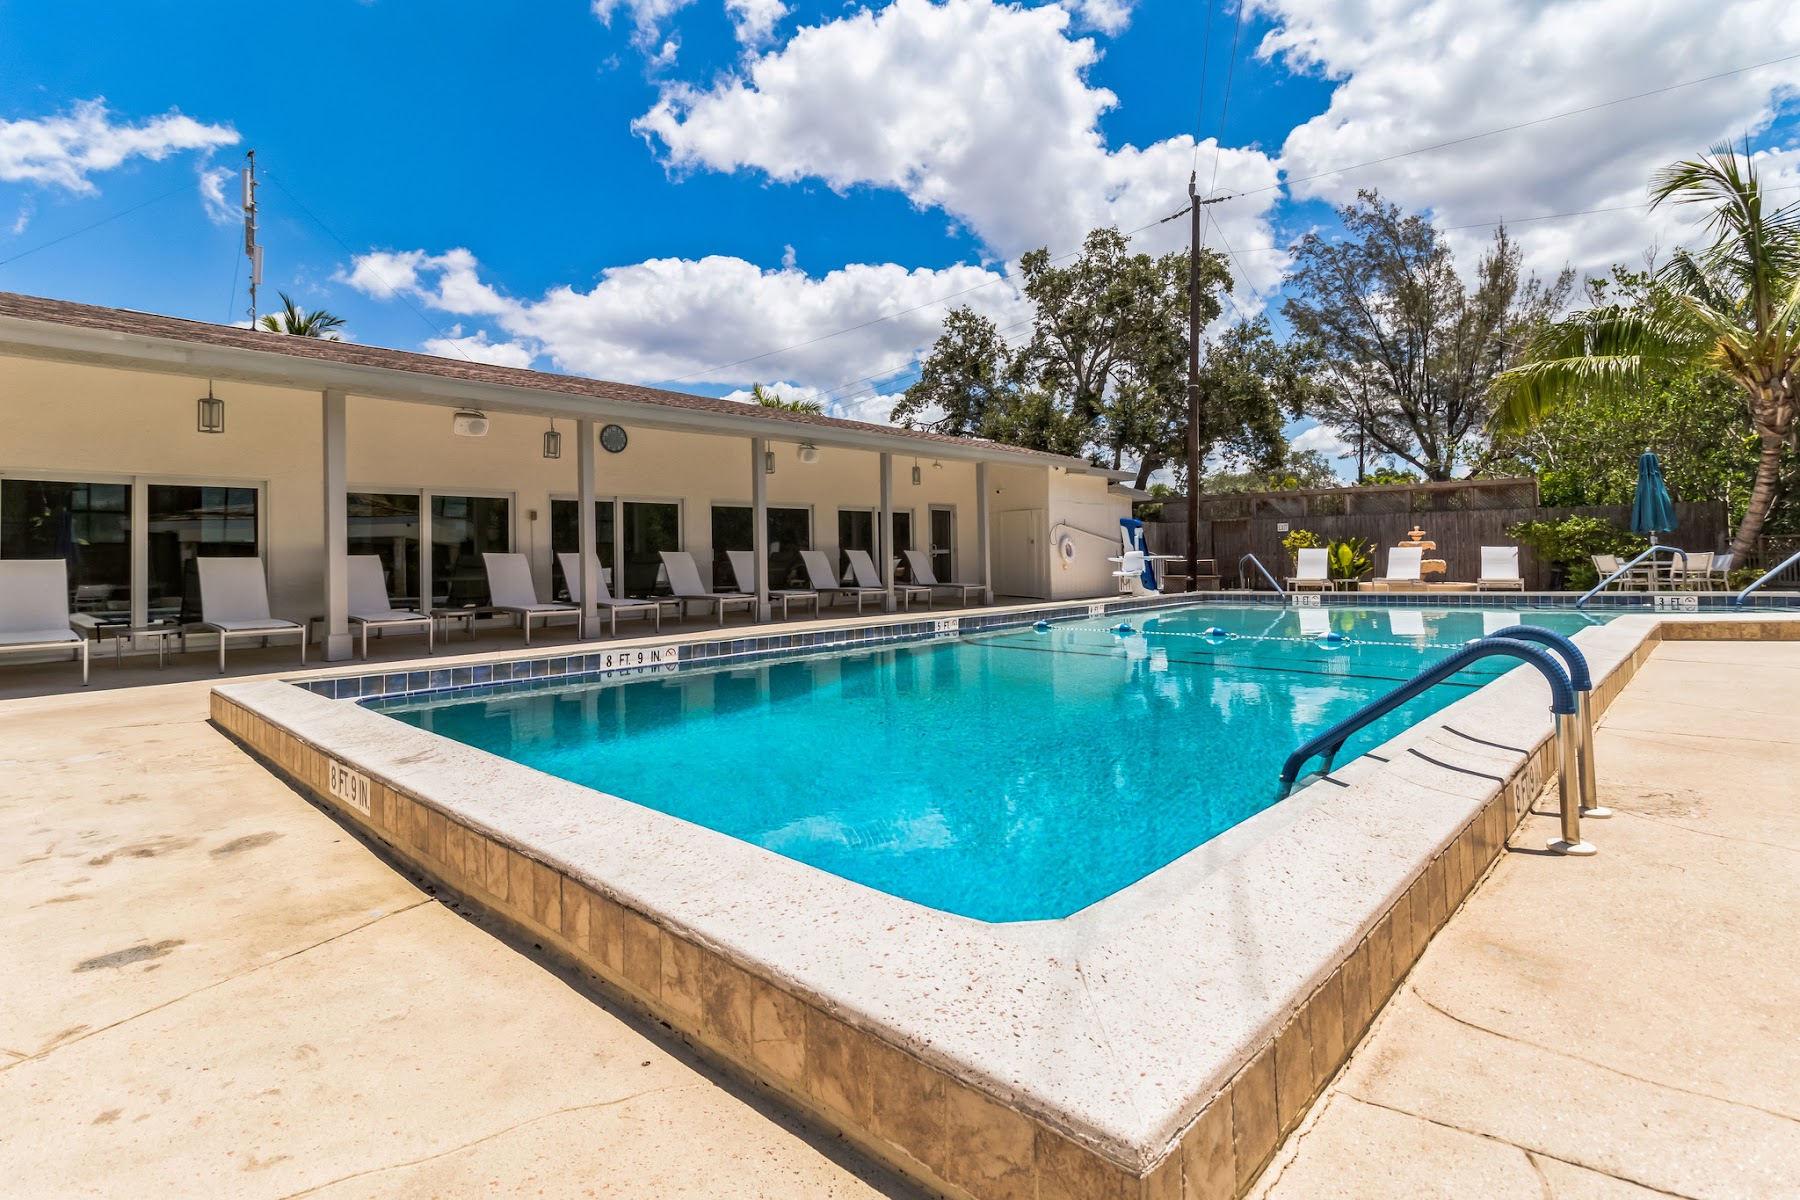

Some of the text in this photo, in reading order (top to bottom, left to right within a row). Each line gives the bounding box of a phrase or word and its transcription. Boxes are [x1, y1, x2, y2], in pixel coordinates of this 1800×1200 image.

[1659, 597, 1664, 605] 3
[606, 650, 662, 667] 8 FT. 9 IN.
[331, 766, 370, 811] 8 FT. 9 IN.
[1515, 784, 1521, 813] 8
